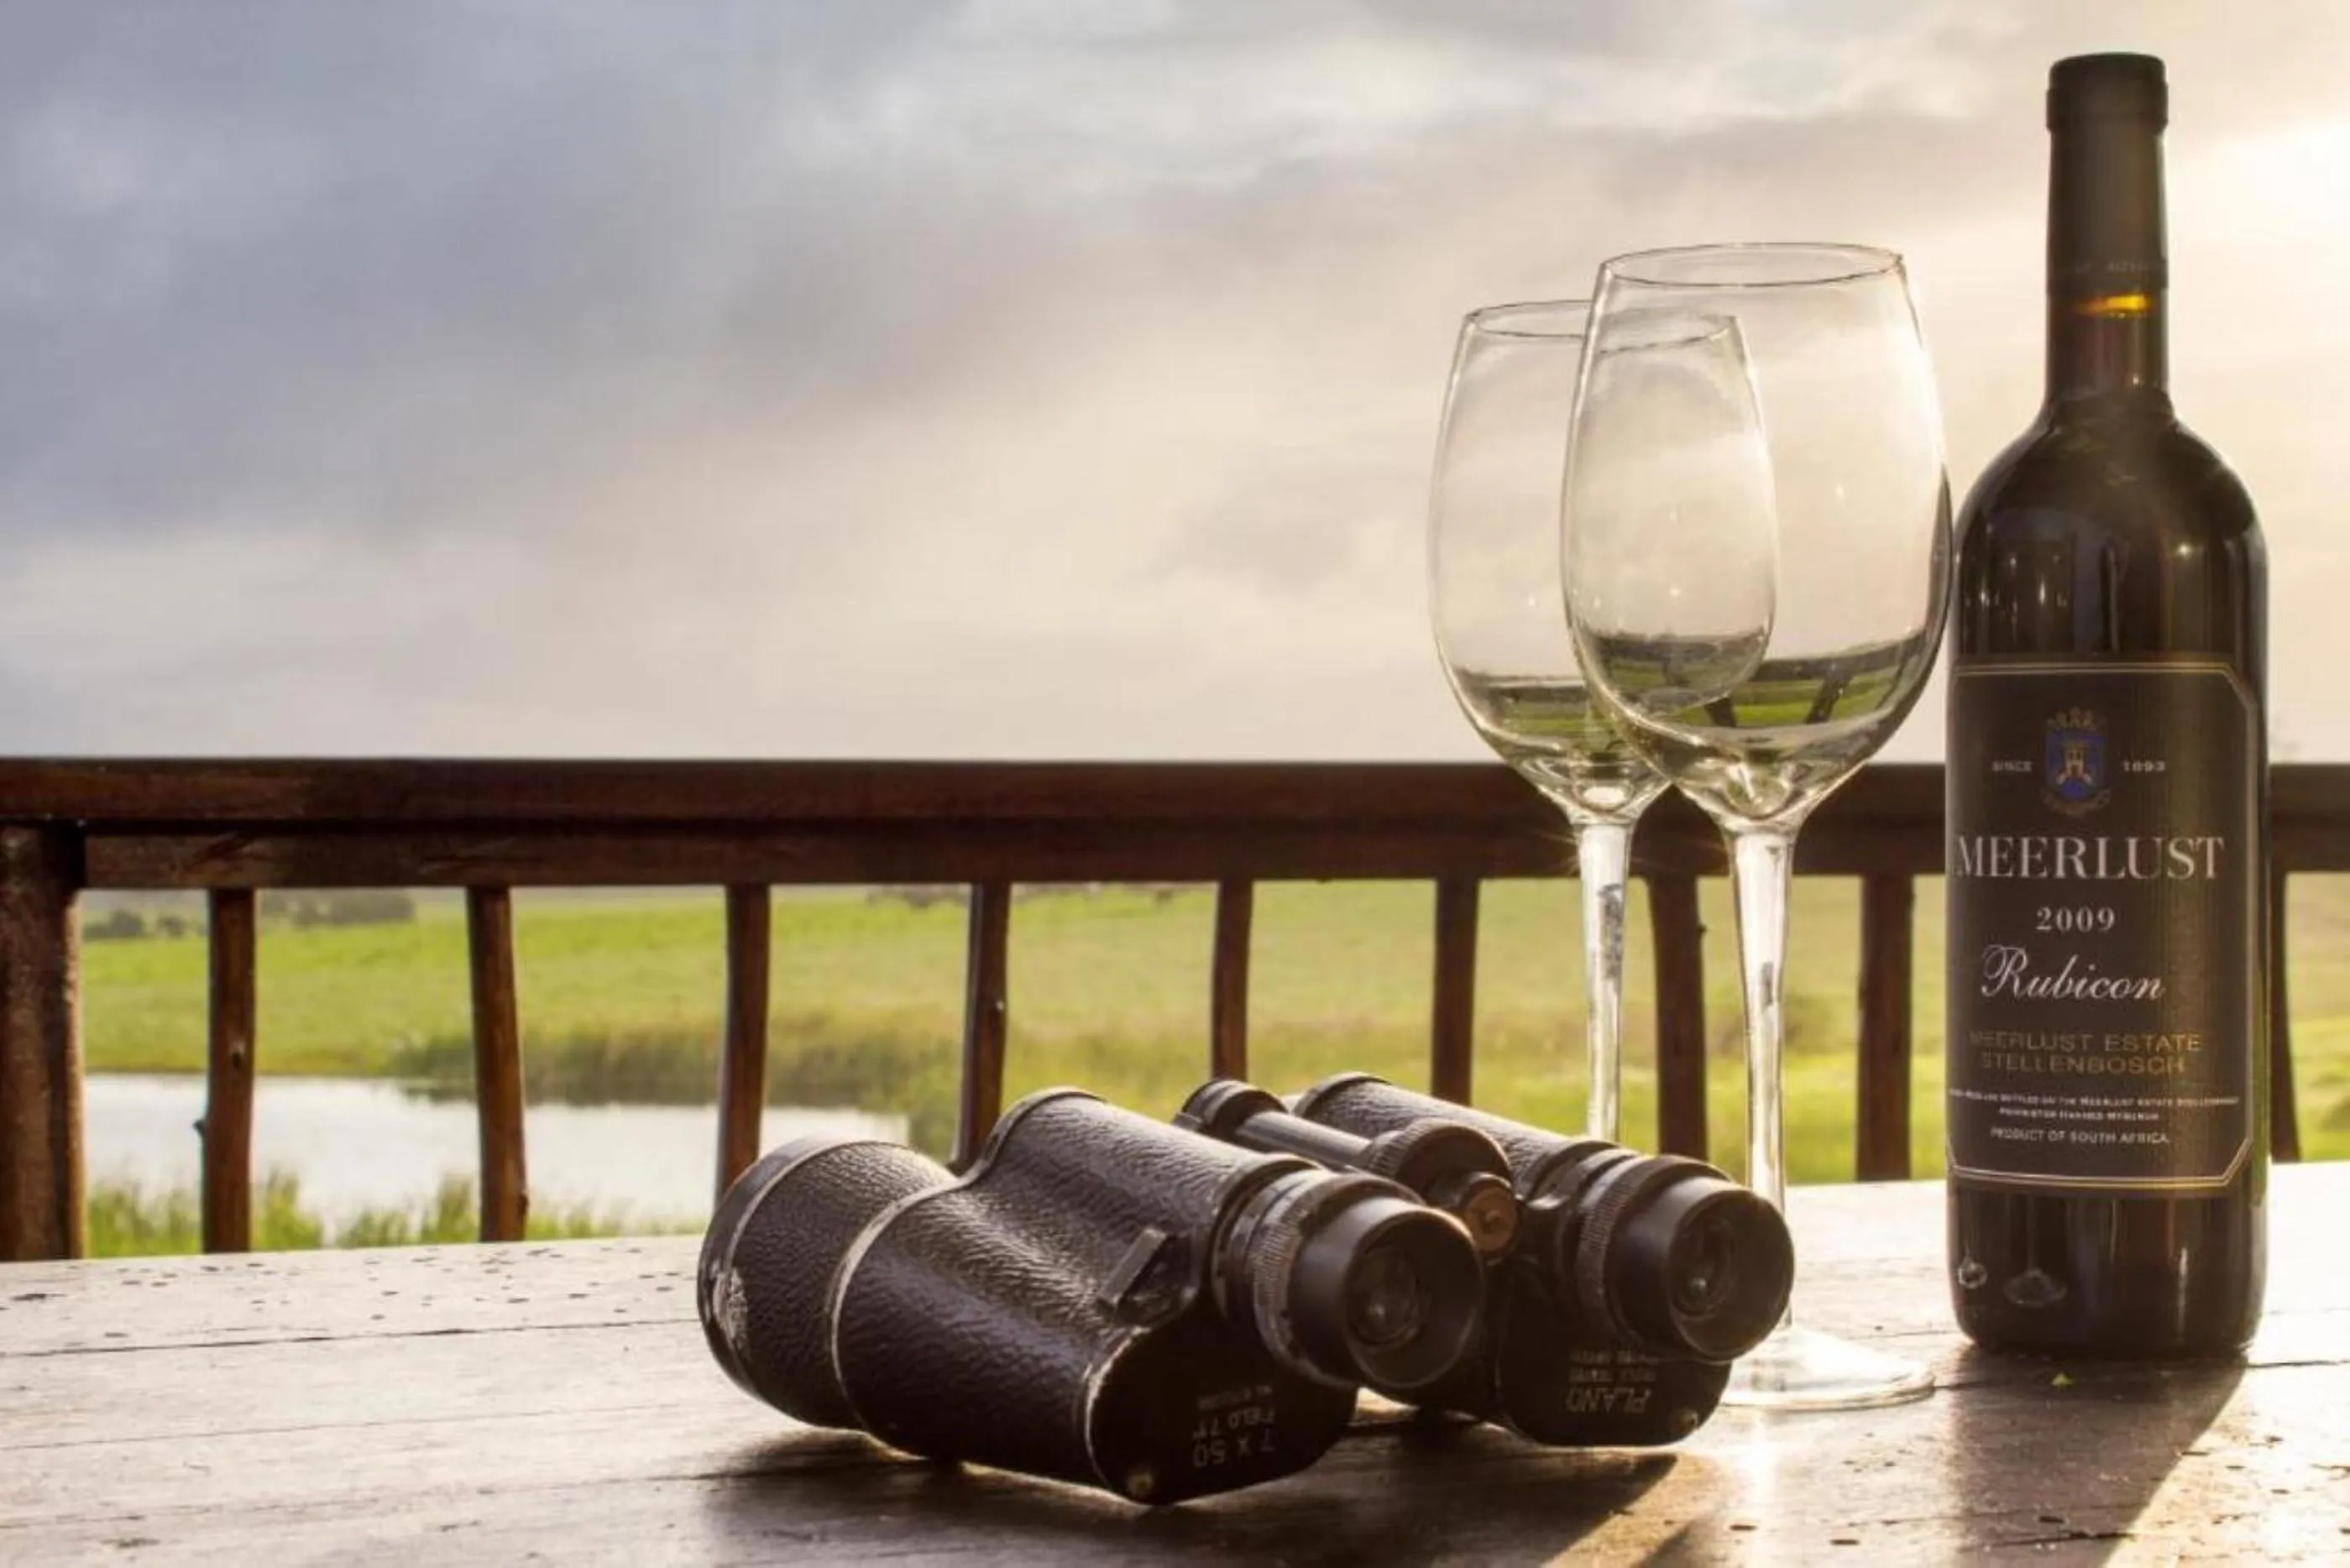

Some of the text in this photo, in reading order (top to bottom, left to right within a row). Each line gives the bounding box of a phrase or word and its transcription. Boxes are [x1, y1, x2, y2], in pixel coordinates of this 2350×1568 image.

[1955, 836, 2224, 880] MEERLUST
[2036, 906, 2116, 933] 2009
[1981, 943, 2166, 1000] Rubicon
[1970, 1030, 2205, 1053] MEERLUST ESTATE
[1981, 1050, 2185, 1075] STELLENBOSCH
[1991, 1126, 2170, 1144] PRODUCT OF SOUTH AFRICA
